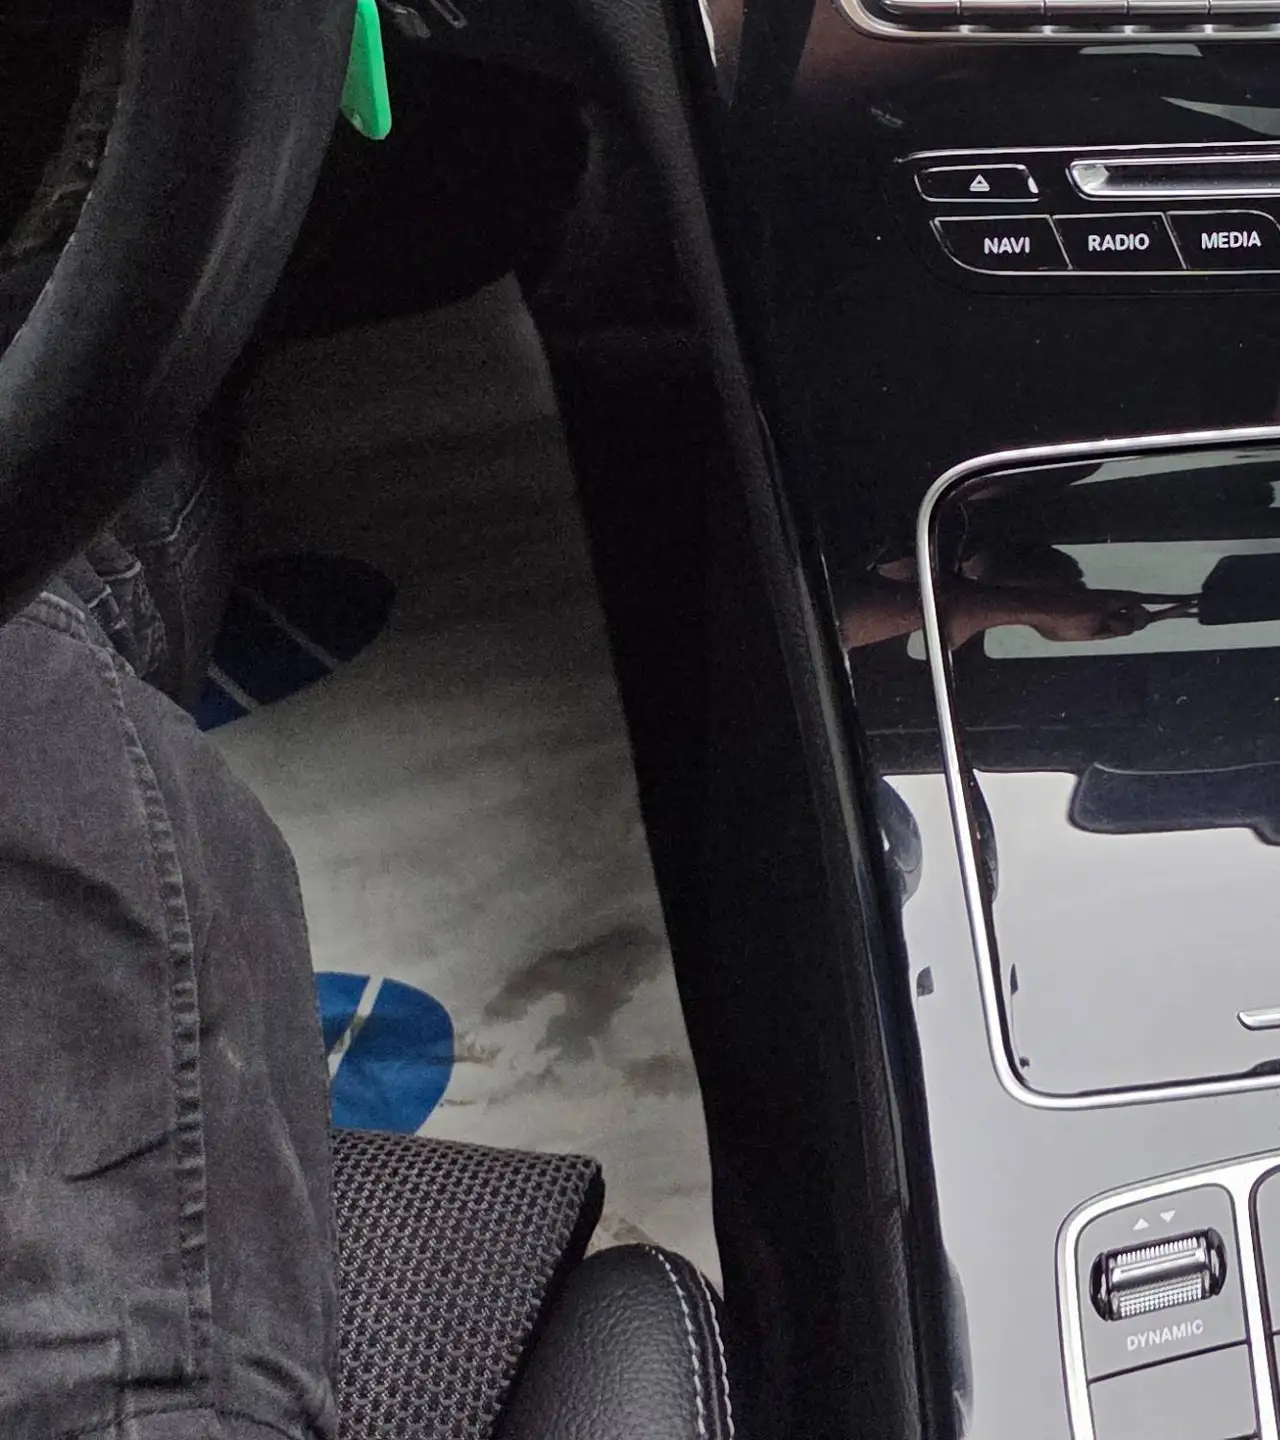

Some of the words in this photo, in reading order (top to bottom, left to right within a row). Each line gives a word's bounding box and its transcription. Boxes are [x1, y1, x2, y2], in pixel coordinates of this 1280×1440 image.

[984, 236, 1031, 255] NAVI
[1087, 233, 1150, 252] RADIO
[1200, 229, 1262, 250] MEDIA
[1126, 1317, 1205, 1353] DYNAMIC
